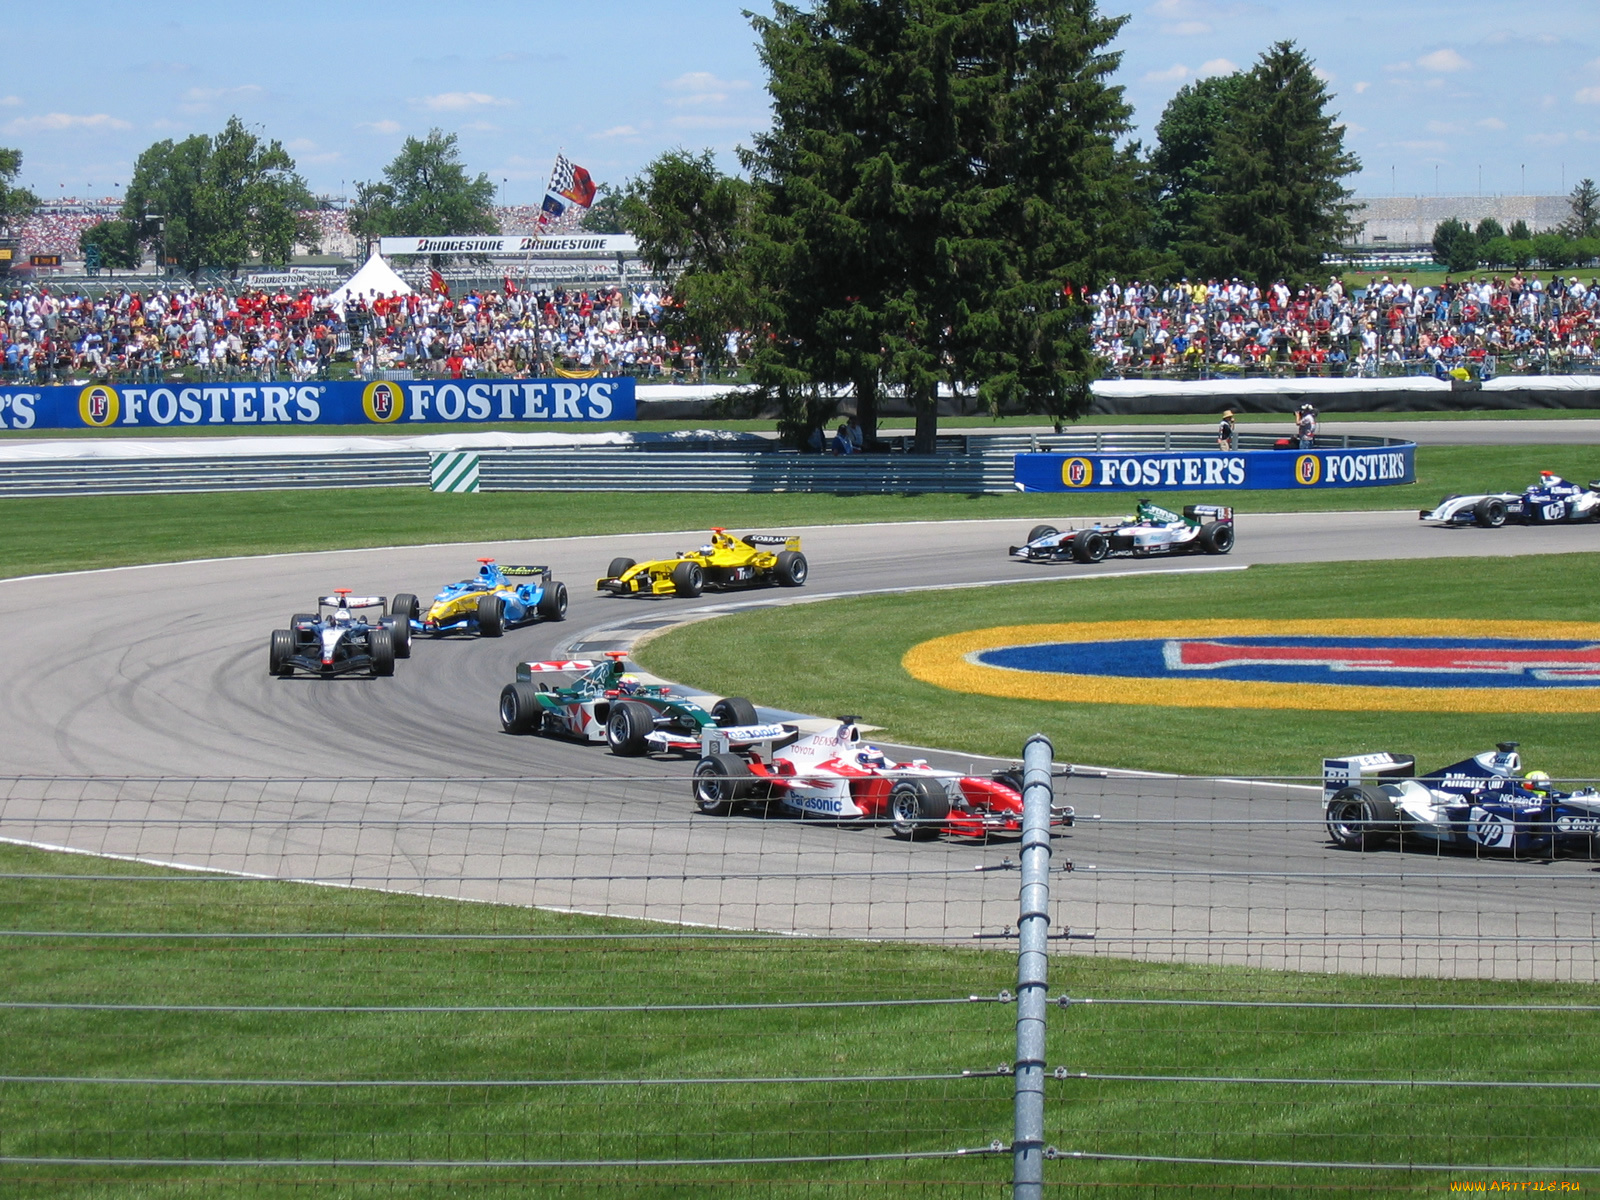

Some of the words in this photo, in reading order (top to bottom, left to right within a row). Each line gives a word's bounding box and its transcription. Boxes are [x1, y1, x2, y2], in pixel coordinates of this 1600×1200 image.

[416, 239, 505, 251] BRIDGESTONE
[519, 238, 607, 250] BRIDGESTONE
[122, 387, 321, 424] FOSTER'S
[408, 382, 613, 421] FOSTER'S
[1100, 457, 1245, 487] FOSTER'S
[1325, 453, 1405, 482] FOSTER'S
[727, 726, 781, 739] nasonic
[812, 735, 839, 747] DENSO
[791, 745, 815, 755] TOYOTA
[1441, 772, 1486, 789] Allianz
[790, 790, 843, 812] Panasonic
[1479, 812, 1502, 846] hp
